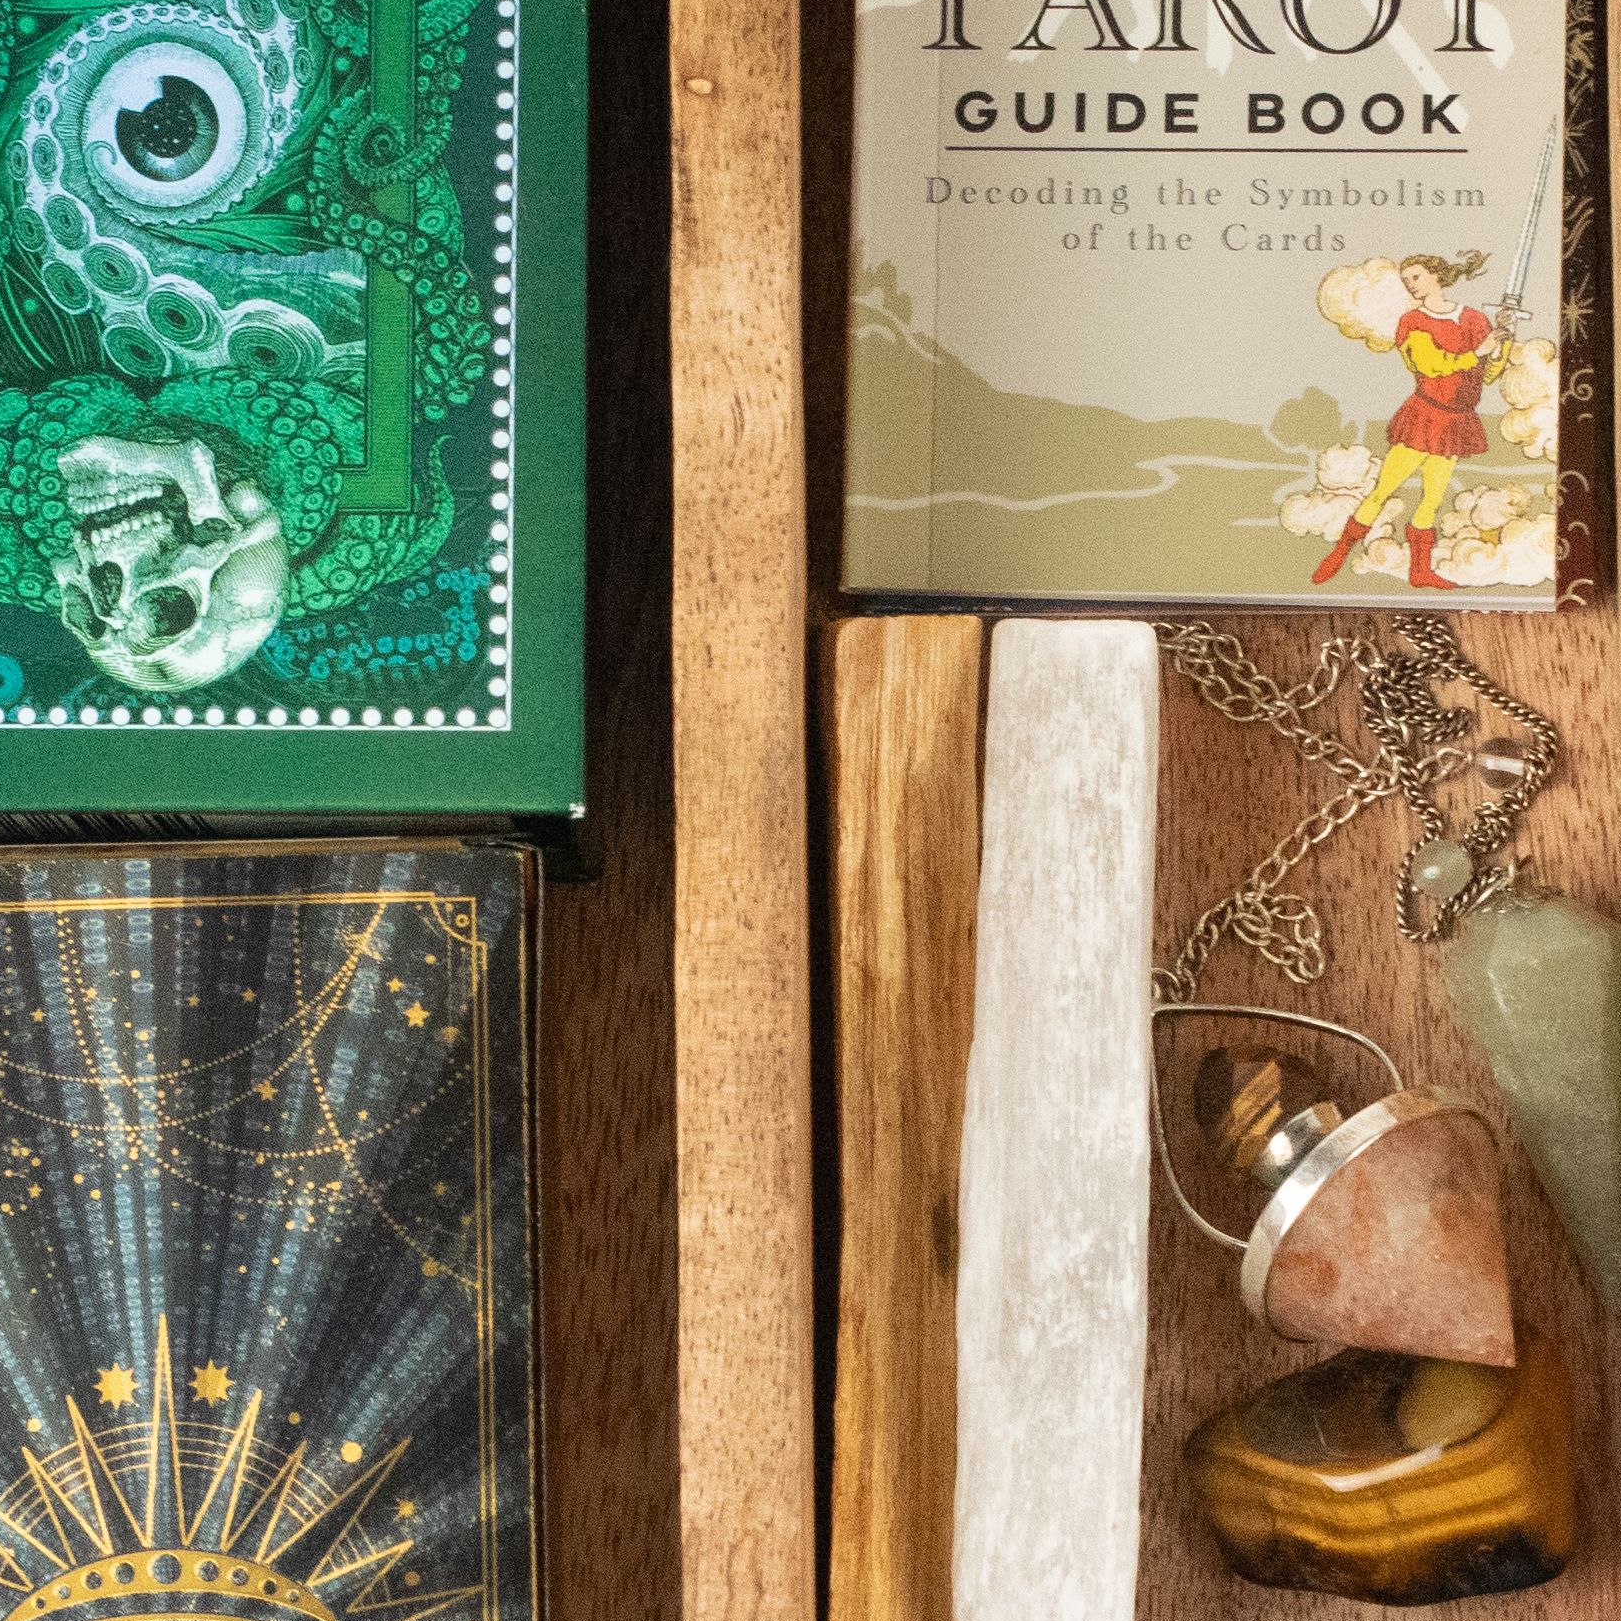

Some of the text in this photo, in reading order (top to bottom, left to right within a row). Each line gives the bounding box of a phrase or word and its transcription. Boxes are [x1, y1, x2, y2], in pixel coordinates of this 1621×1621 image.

[953, 89, 1462, 137] GUIDE BOOK
[924, 175, 1486, 216] Decoding the Symbolism
[1061, 222, 1347, 253] of the Cards
